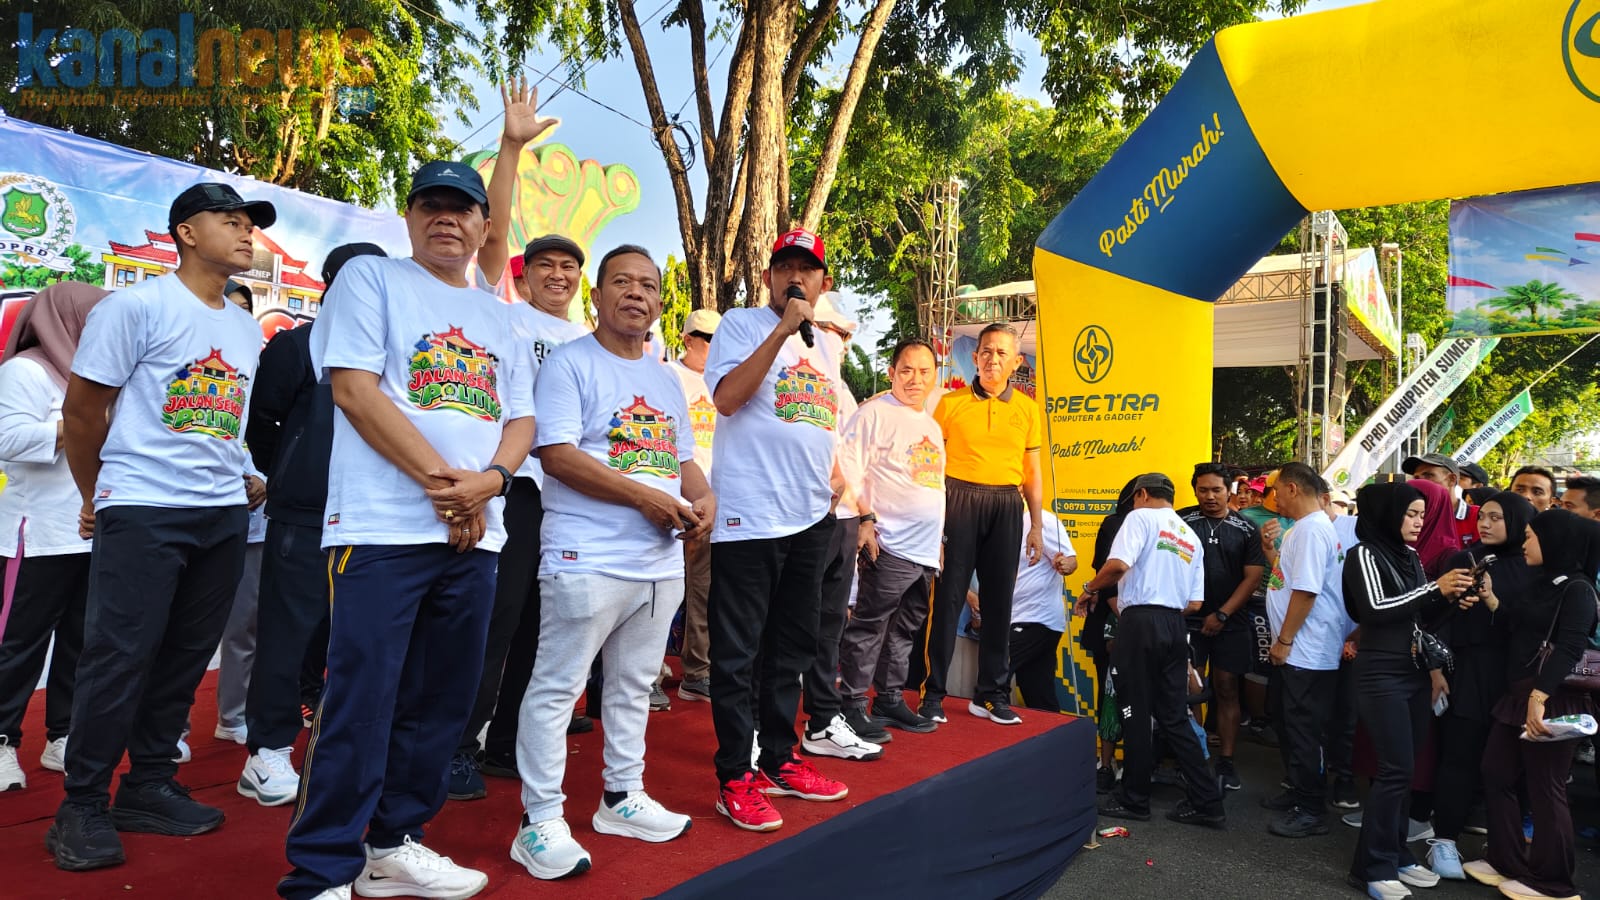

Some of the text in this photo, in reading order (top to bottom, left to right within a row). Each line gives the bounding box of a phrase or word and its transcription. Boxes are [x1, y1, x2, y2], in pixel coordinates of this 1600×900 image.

[1099, 112, 1225, 257] Pasti Murah!
[408, 367, 465, 392] JALAN
[163, 394, 213, 413] JALAN
[775, 391, 811, 409] JALAN
[1045, 393, 1160, 414] SPECTRA
[1360, 422, 1388, 452] DPRD
[1384, 368, 1440, 428] KABUPATEN
[1053, 414, 1094, 422] COMPUTER
[1104, 413, 1143, 421] GADGET
[1464, 426, 1496, 457] KABUPATEN
[1494, 403, 1521, 429] SUMENEP
[608, 438, 653, 458] JALAN
[1052, 435, 1146, 458] Pasti Murah!
[1063, 502, 1086, 511] 0878
[1088, 503, 1112, 511] 7857
[1254, 615, 1271, 664] adidas
